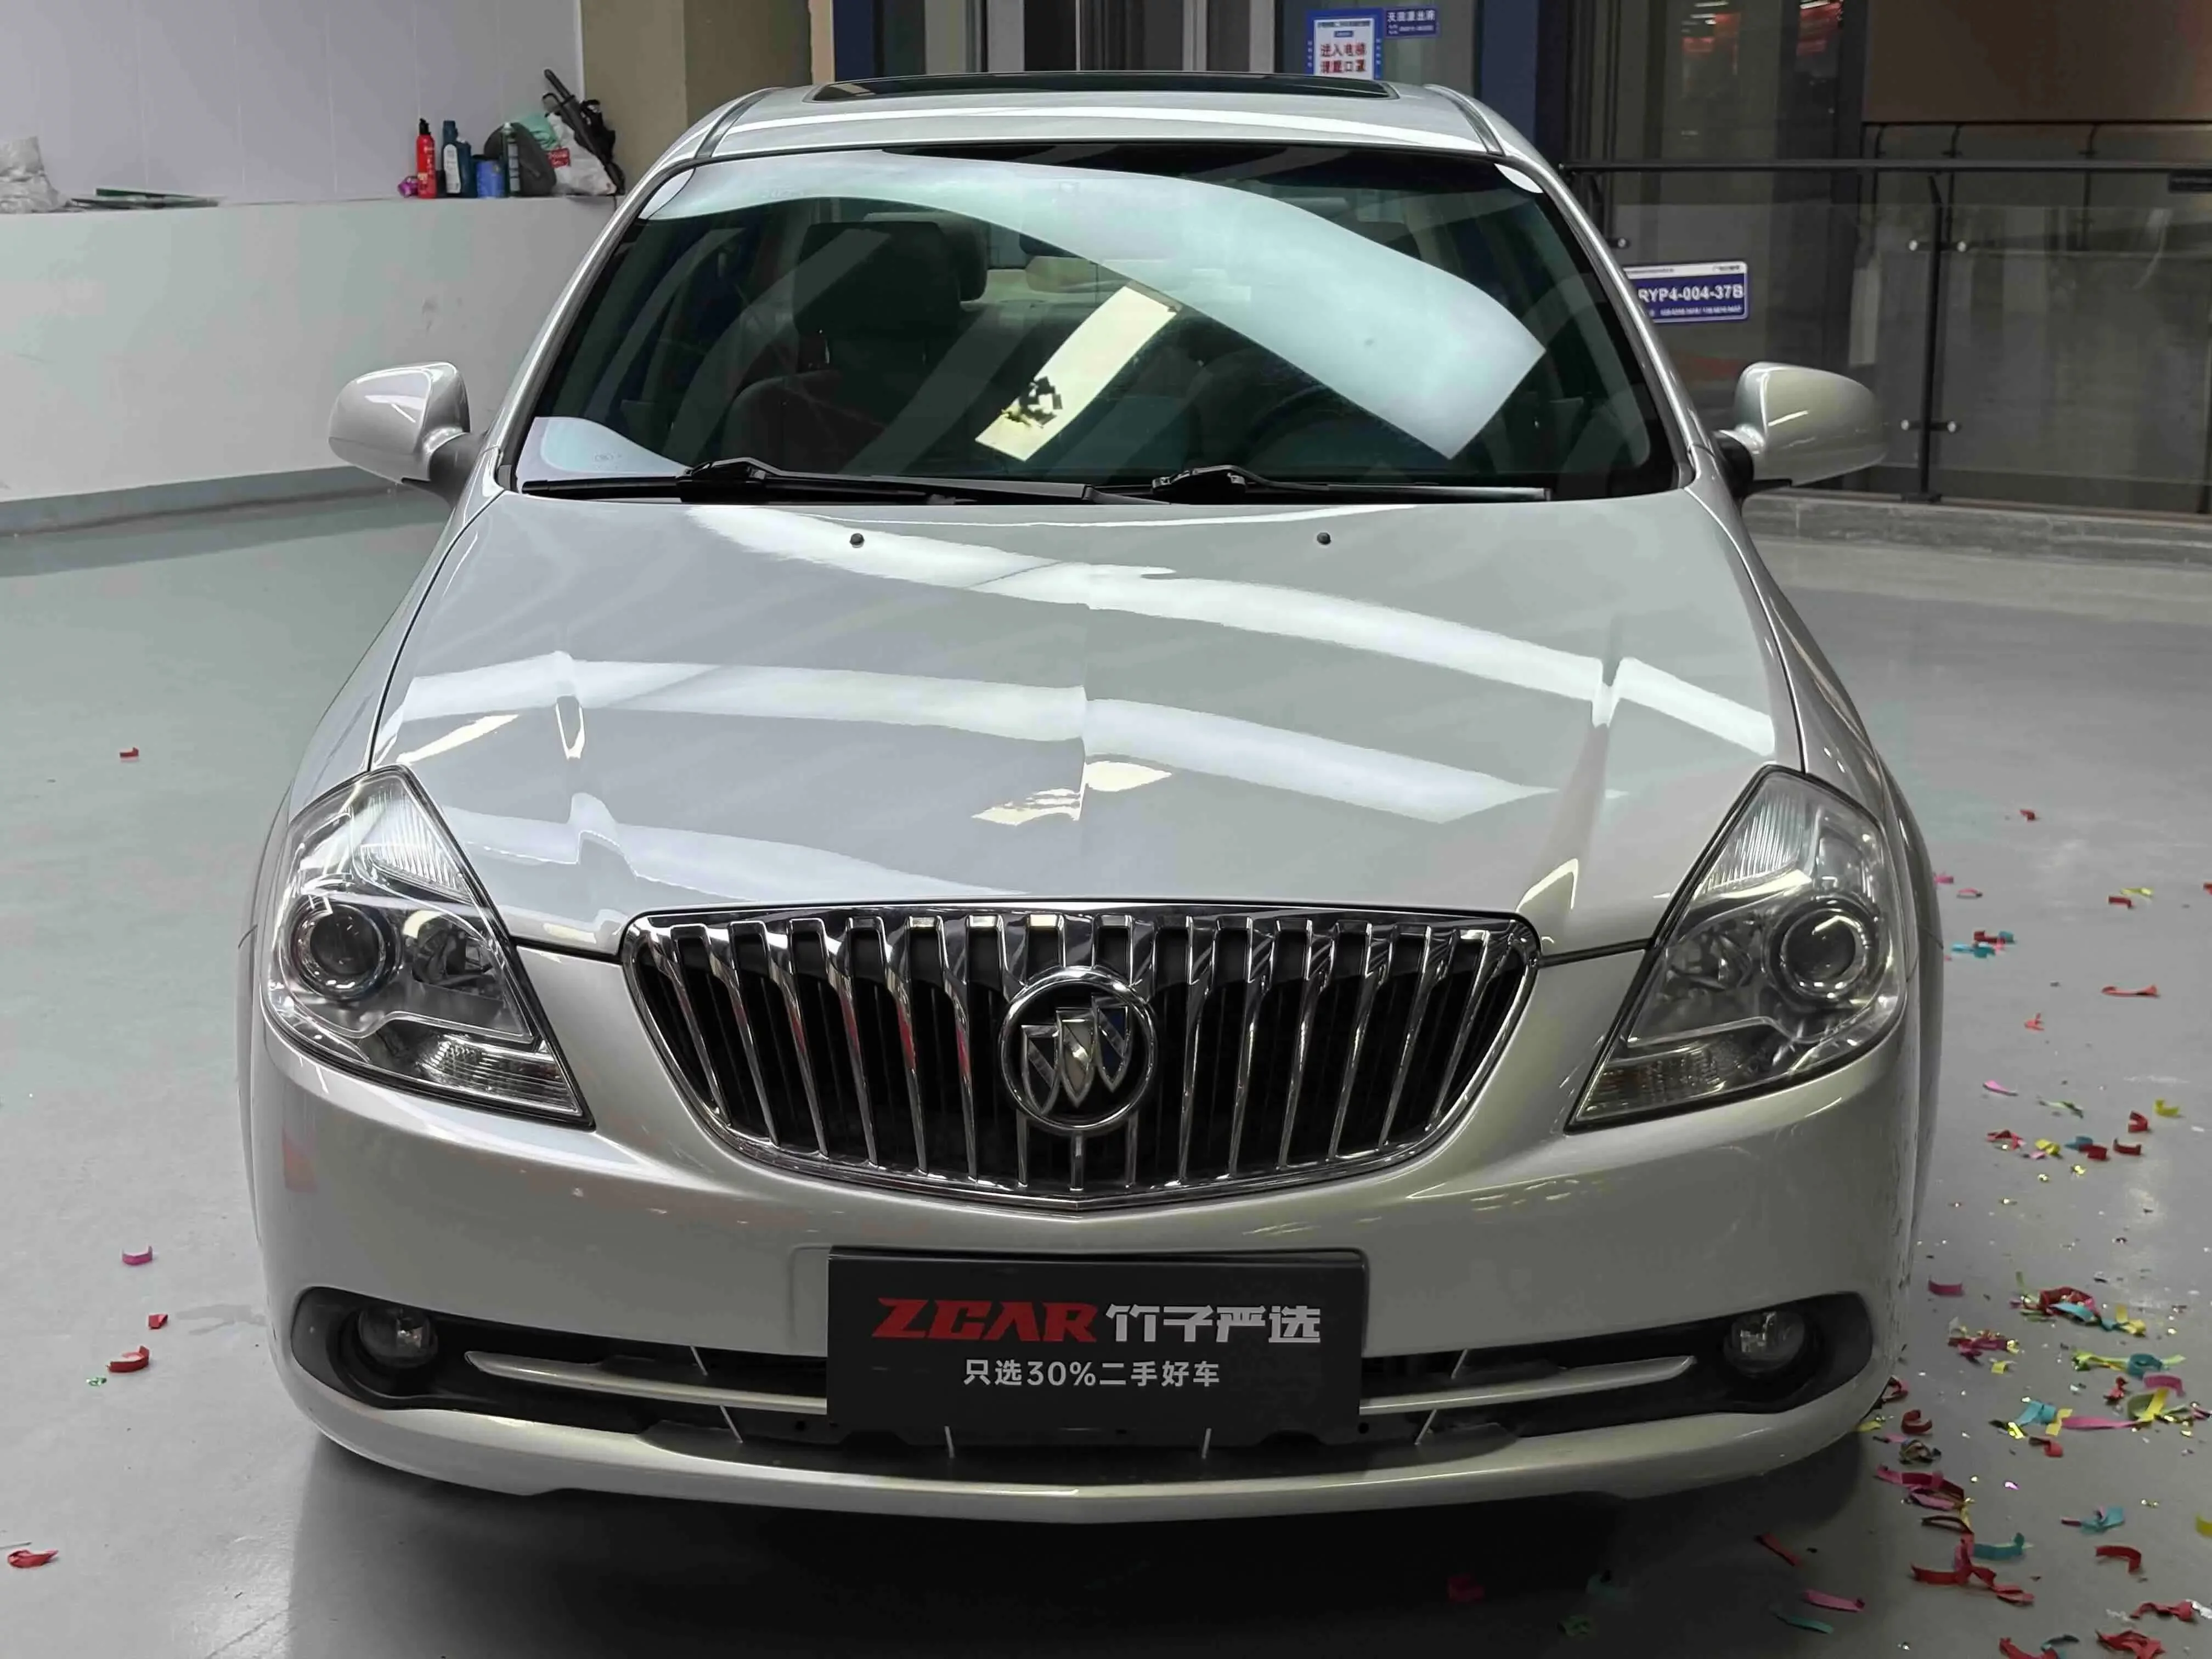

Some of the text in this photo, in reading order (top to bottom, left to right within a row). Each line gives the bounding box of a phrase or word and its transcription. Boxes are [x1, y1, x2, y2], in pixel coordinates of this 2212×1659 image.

[1638, 284, 1743, 303] RYP4-004-37B
[872, 1298, 1321, 1344] ZCAR 竹子严选
[963, 1358, 1220, 1387] 只选30%二手好车
